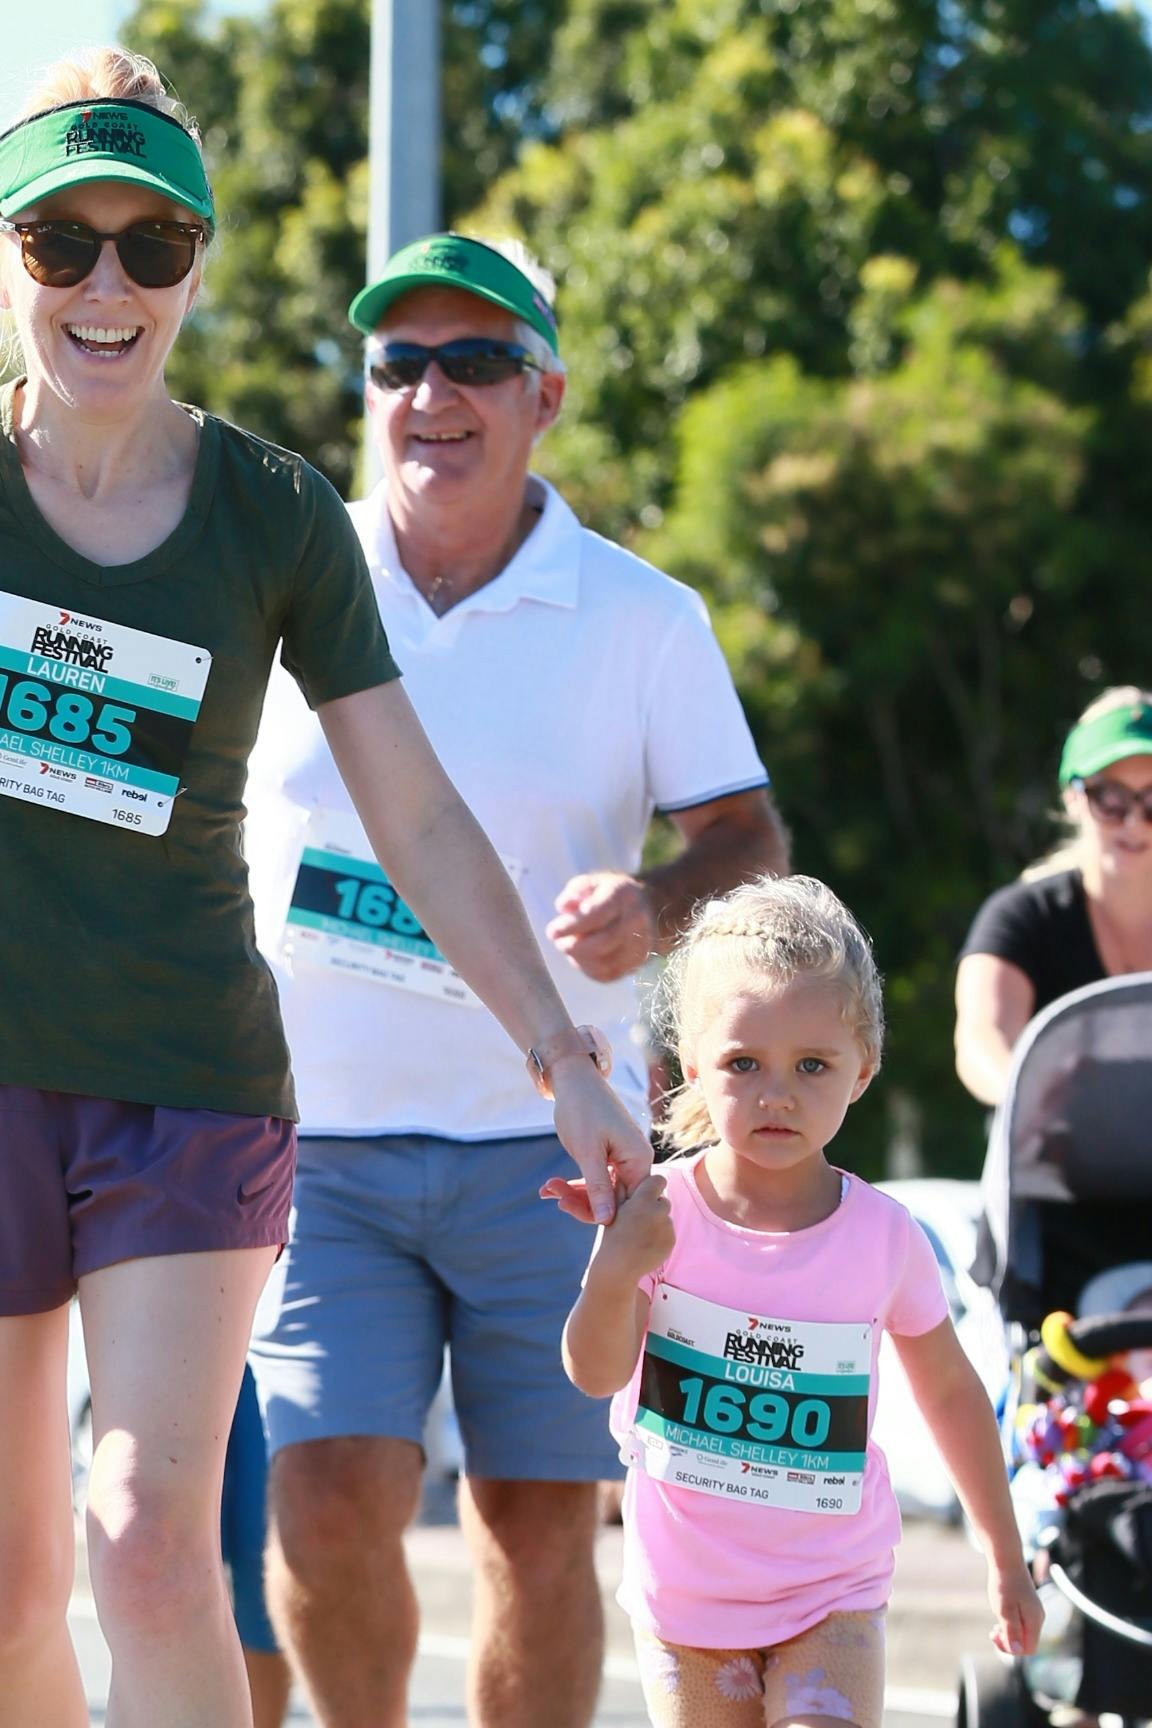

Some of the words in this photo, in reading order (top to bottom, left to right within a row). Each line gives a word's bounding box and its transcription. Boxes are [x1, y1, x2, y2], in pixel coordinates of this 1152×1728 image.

[66, 127, 145, 146] RUNNING
[66, 140, 147, 158] FESTIVAL
[33, 626, 114, 661] RUNNING
[46, 624, 71, 635] GOLD
[76, 632, 108, 645] COAST
[30, 640, 109, 674] FESTIVAL
[27, 657, 106, 694] LAUREN
[29, 741, 99, 770] SHELLEY
[100, 761, 130, 781] 1KM
[23, 784, 44, 798] BAG
[46, 790, 66, 803] TAG
[121, 789, 148, 802] rebel
[112, 809, 143, 825] 1685
[725, 1332, 805, 1358] RUNNING
[736, 1329, 761, 1339] GOLD
[767, 1335, 798, 1344] COAST
[723, 1346, 802, 1371] FESTIVAL
[724, 1362, 796, 1392] LOUISA
[679, 1377, 831, 1448] 1690
[665, 1424, 726, 1455] MICHAEL
[729, 1441, 798, 1467] SHELLEY
[801, 1454, 830, 1470] 1KM
[675, 1471, 725, 1491] SECURITY
[726, 1483, 748, 1496] BAG
[750, 1487, 769, 1499] TAG
[815, 1498, 843, 1509] 1690
